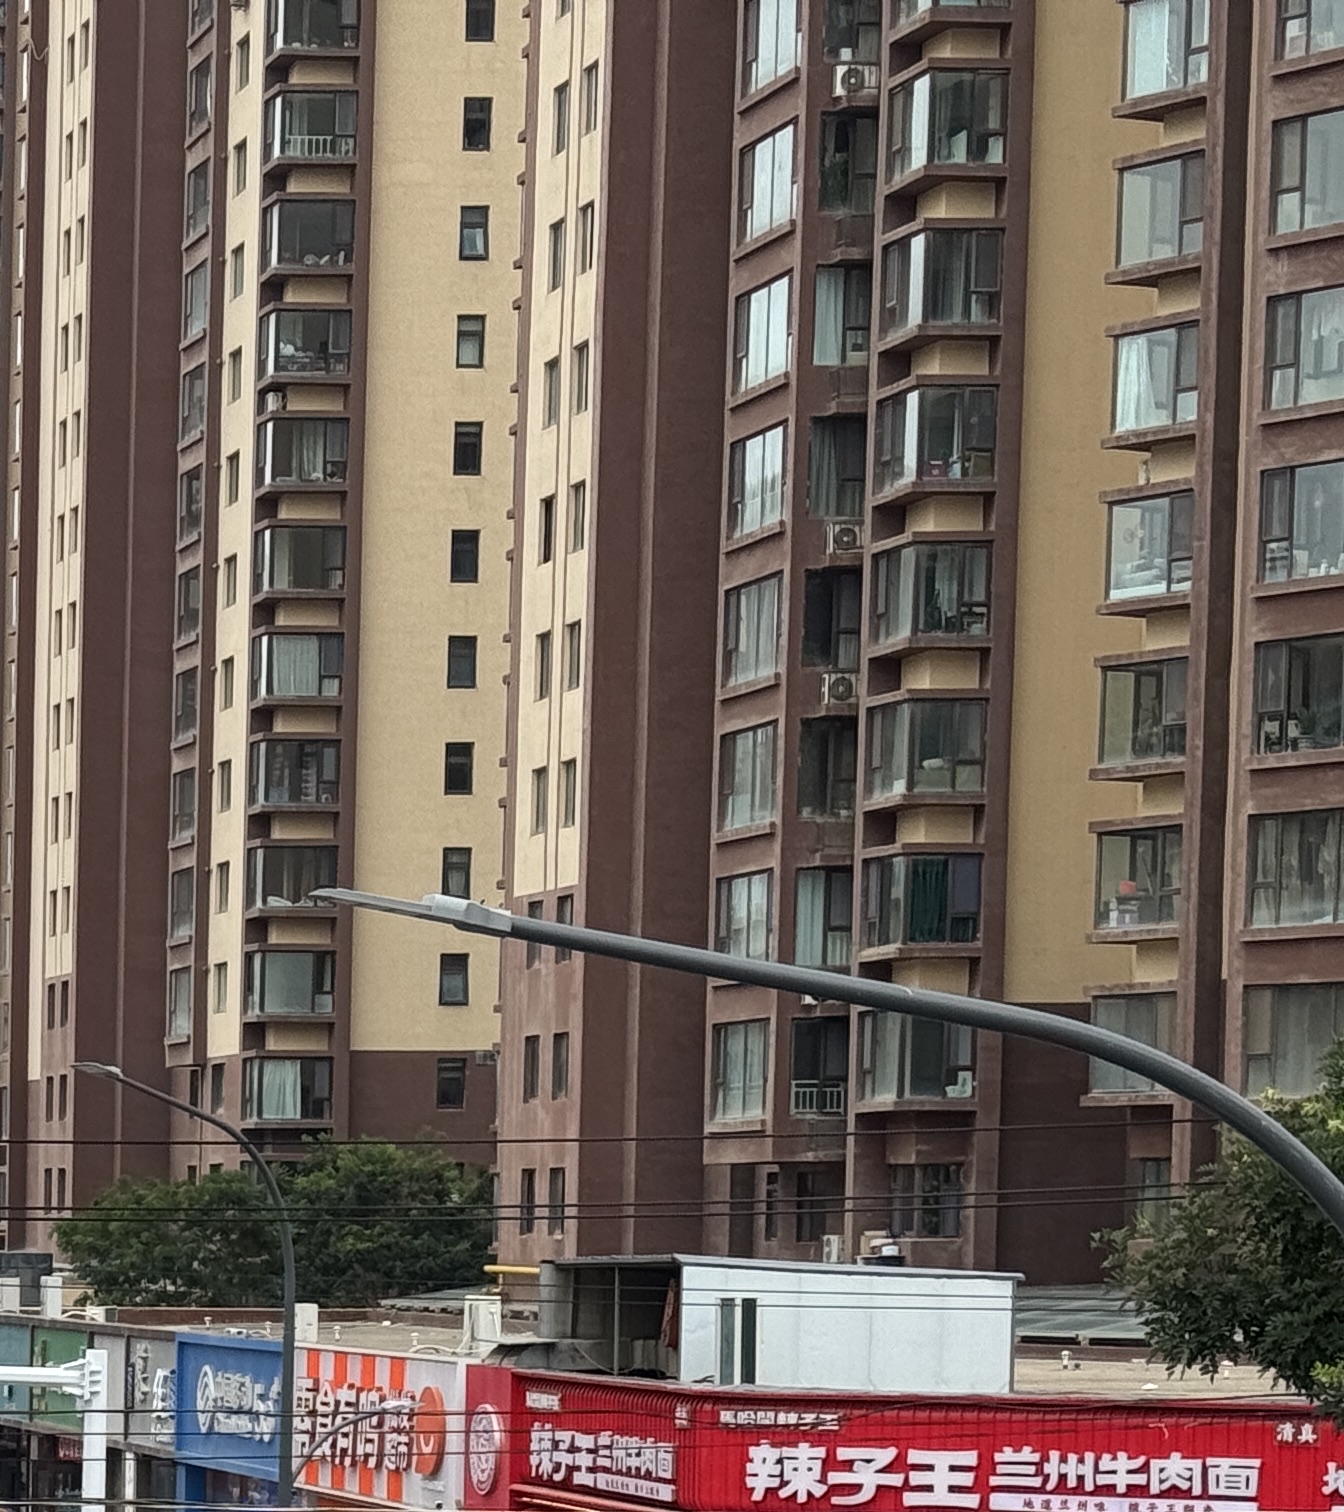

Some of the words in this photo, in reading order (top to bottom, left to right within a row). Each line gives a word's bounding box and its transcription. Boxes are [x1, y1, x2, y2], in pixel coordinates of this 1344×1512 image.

[1276, 1422, 1318, 1444] 清真
[745, 1440, 981, 1510] 辣子王
[989, 1446, 1262, 1498] 兰州牛肉面
